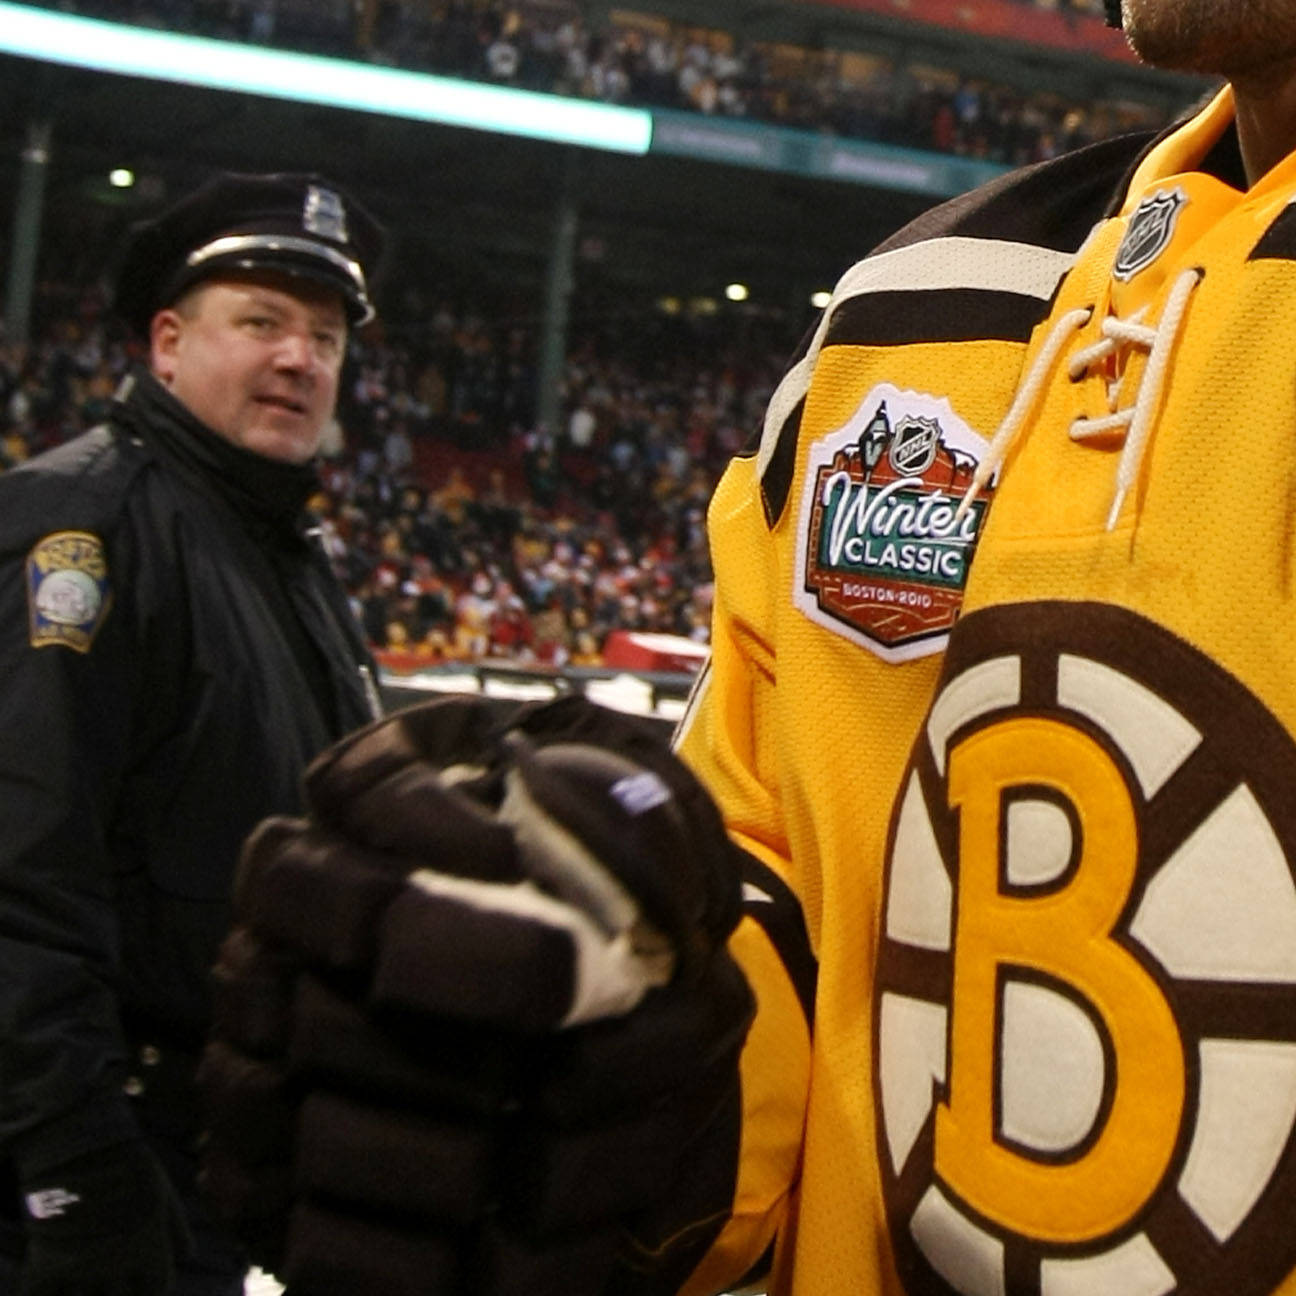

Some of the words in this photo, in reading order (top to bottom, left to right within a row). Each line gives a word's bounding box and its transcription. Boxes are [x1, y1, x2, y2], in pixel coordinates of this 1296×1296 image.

[822, 471, 977, 566] Winter
[844, 537, 962, 576] CLASSIC
[933, 716, 1186, 1245] B
